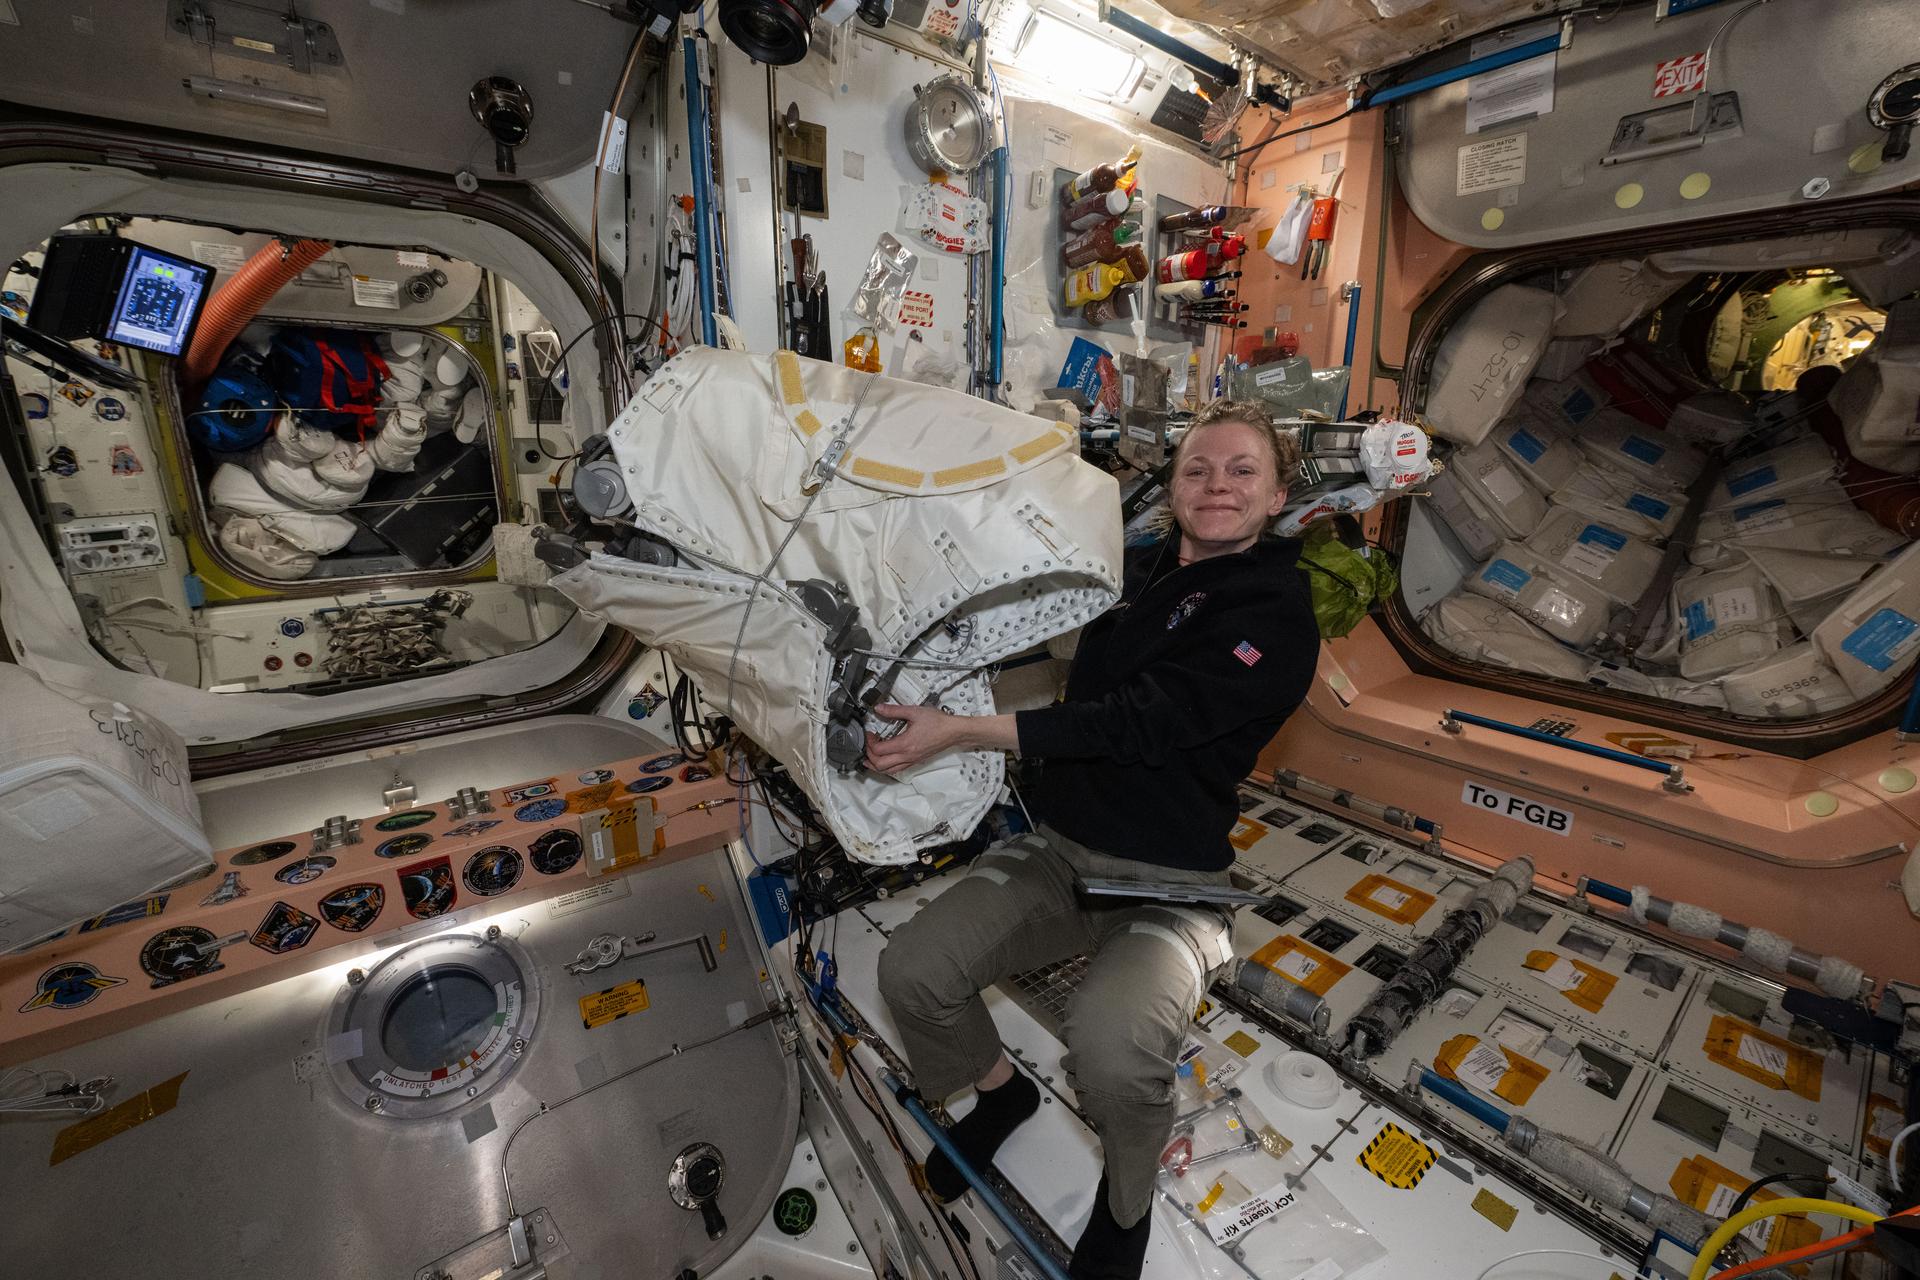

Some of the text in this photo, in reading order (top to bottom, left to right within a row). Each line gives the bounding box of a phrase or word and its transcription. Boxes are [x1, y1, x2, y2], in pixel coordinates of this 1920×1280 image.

[1661, 64, 1697, 88] EXIT
[1470, 137, 1518, 153] CLOSING HATCH
[935, 231, 965, 246] HUGGIES
[903, 304, 929, 313] FIRE PORT
[1469, 330, 1526, 402] 10-5247
[1396, 438, 1416, 446] HUGGIES
[1760, 676, 1821, 700] 05-5369
[1469, 784, 1568, 831] To FGB
[597, 989, 630, 1005] WARNING
[503, 993, 514, 1028] LATCHED
[383, 1075, 436, 1090] UNLATCHED
[440, 1073, 463, 1086] TEST
[1272, 1191, 1295, 1209] ACY
[1239, 1203, 1275, 1228] Inserts
[1223, 1222, 1240, 1237] Kit
